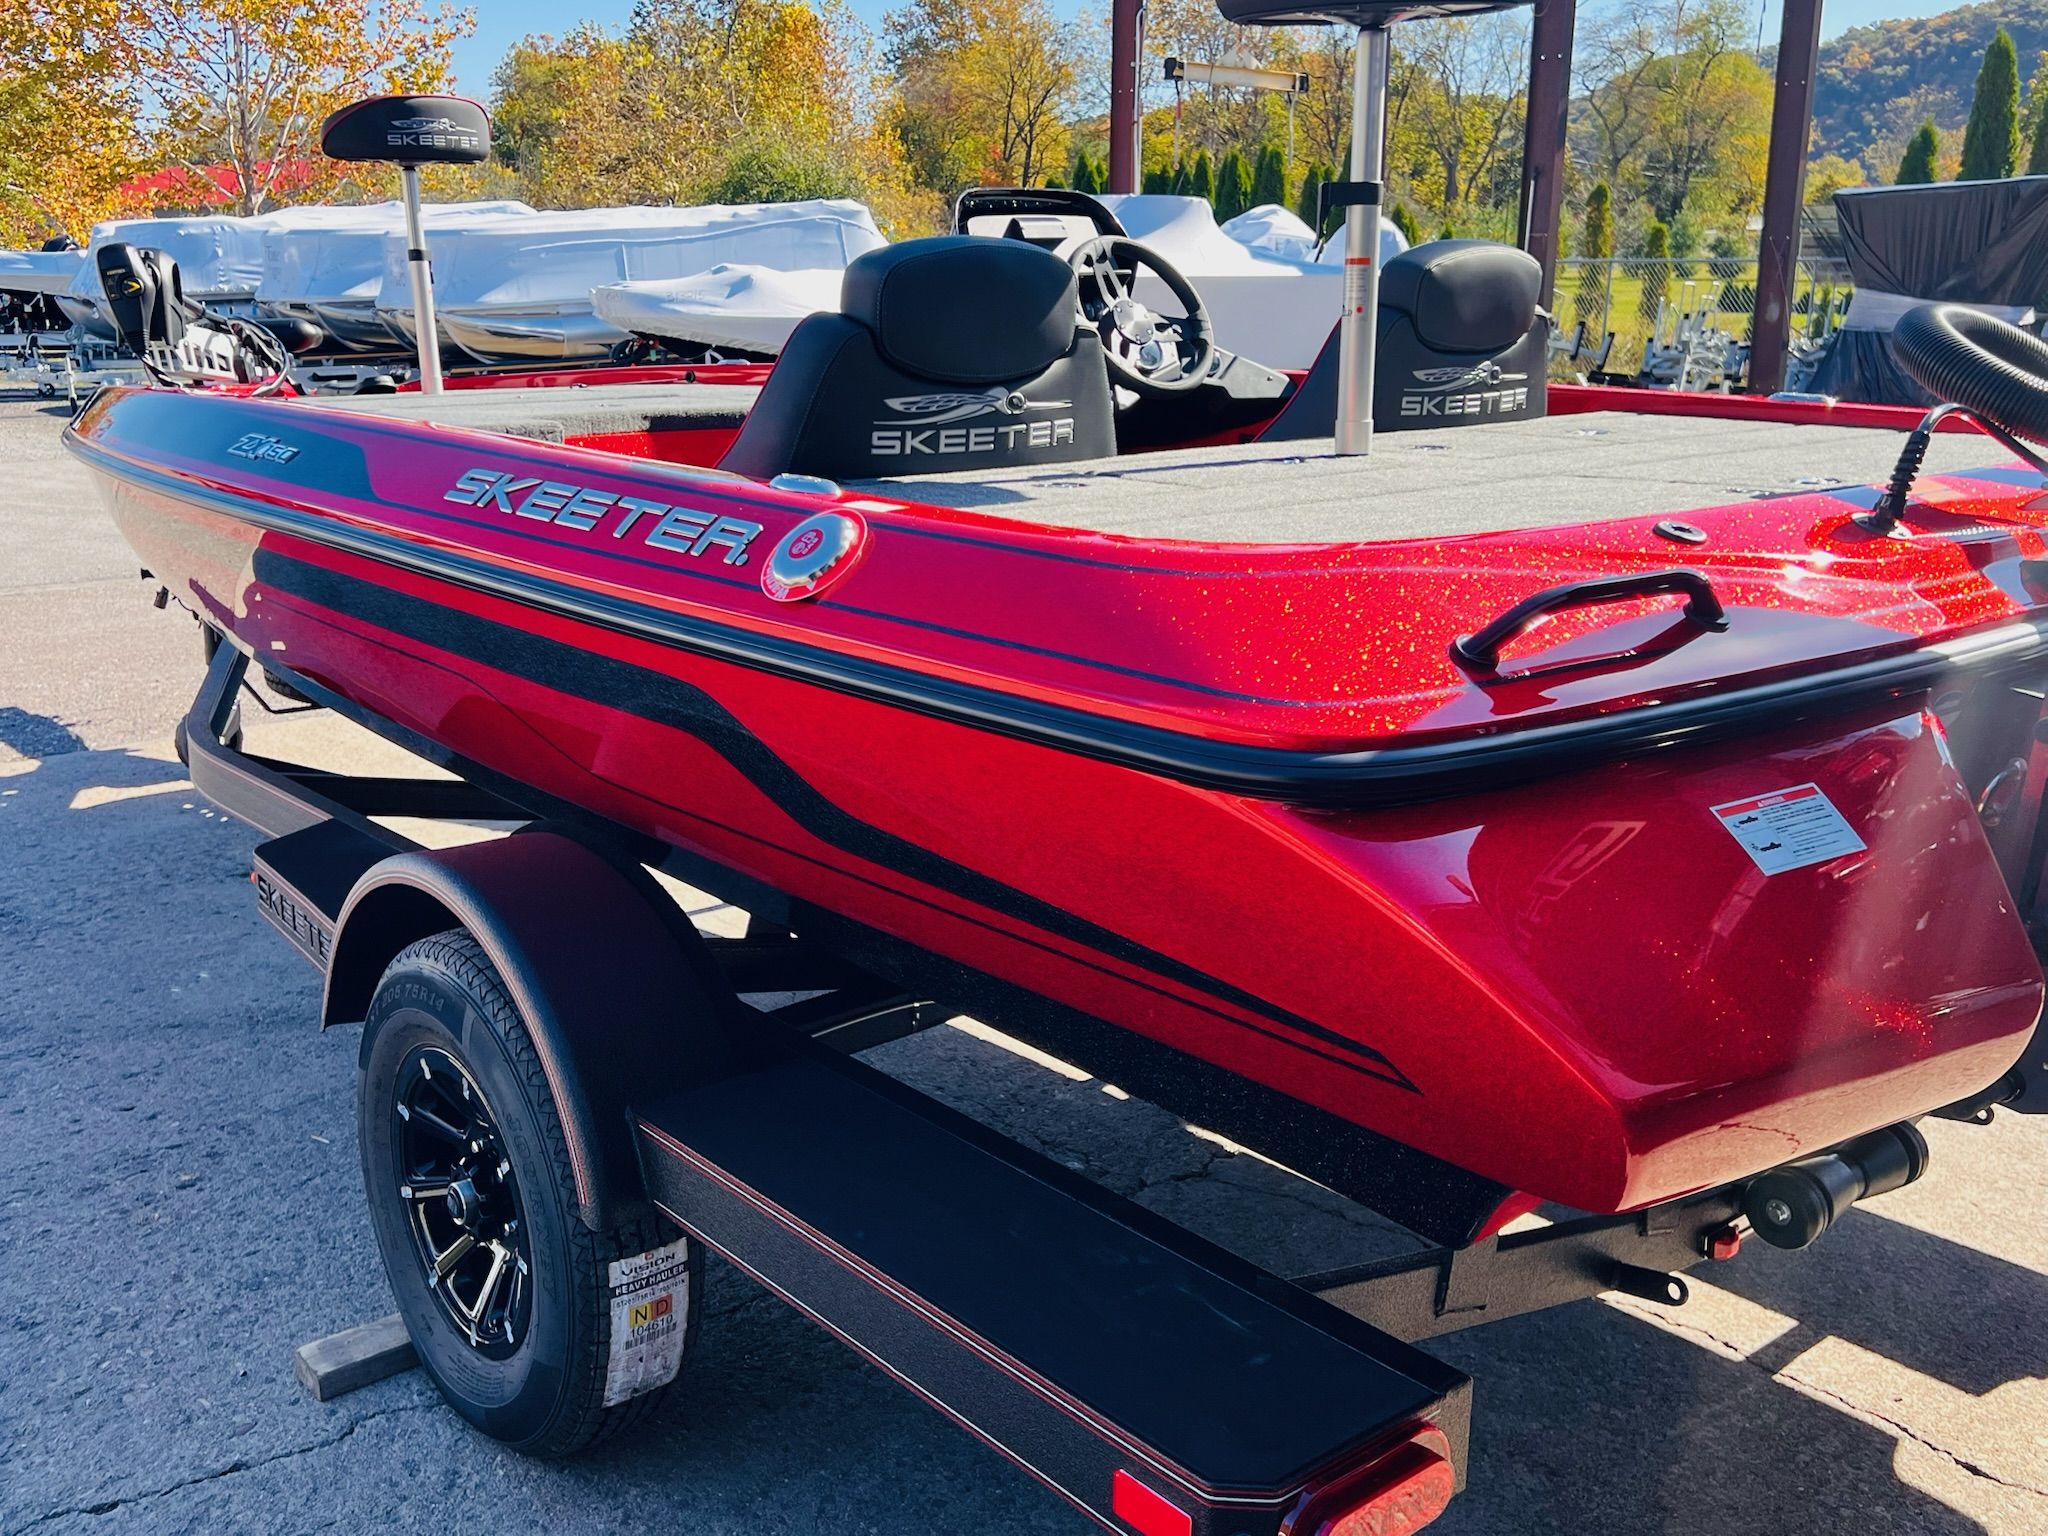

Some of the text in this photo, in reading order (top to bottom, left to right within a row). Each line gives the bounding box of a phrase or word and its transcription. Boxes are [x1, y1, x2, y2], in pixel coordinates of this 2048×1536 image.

[387, 134, 479, 149] SKEETER
[1400, 387, 1528, 416] SKEETER
[871, 418, 1074, 455] SKEETER
[257, 874, 333, 962] SKEETE
[621, 1252, 676, 1277] VISION
[615, 1279, 648, 1297] HEAVY
[649, 1263, 686, 1284] HAULER
[635, 1299, 669, 1325] N D
